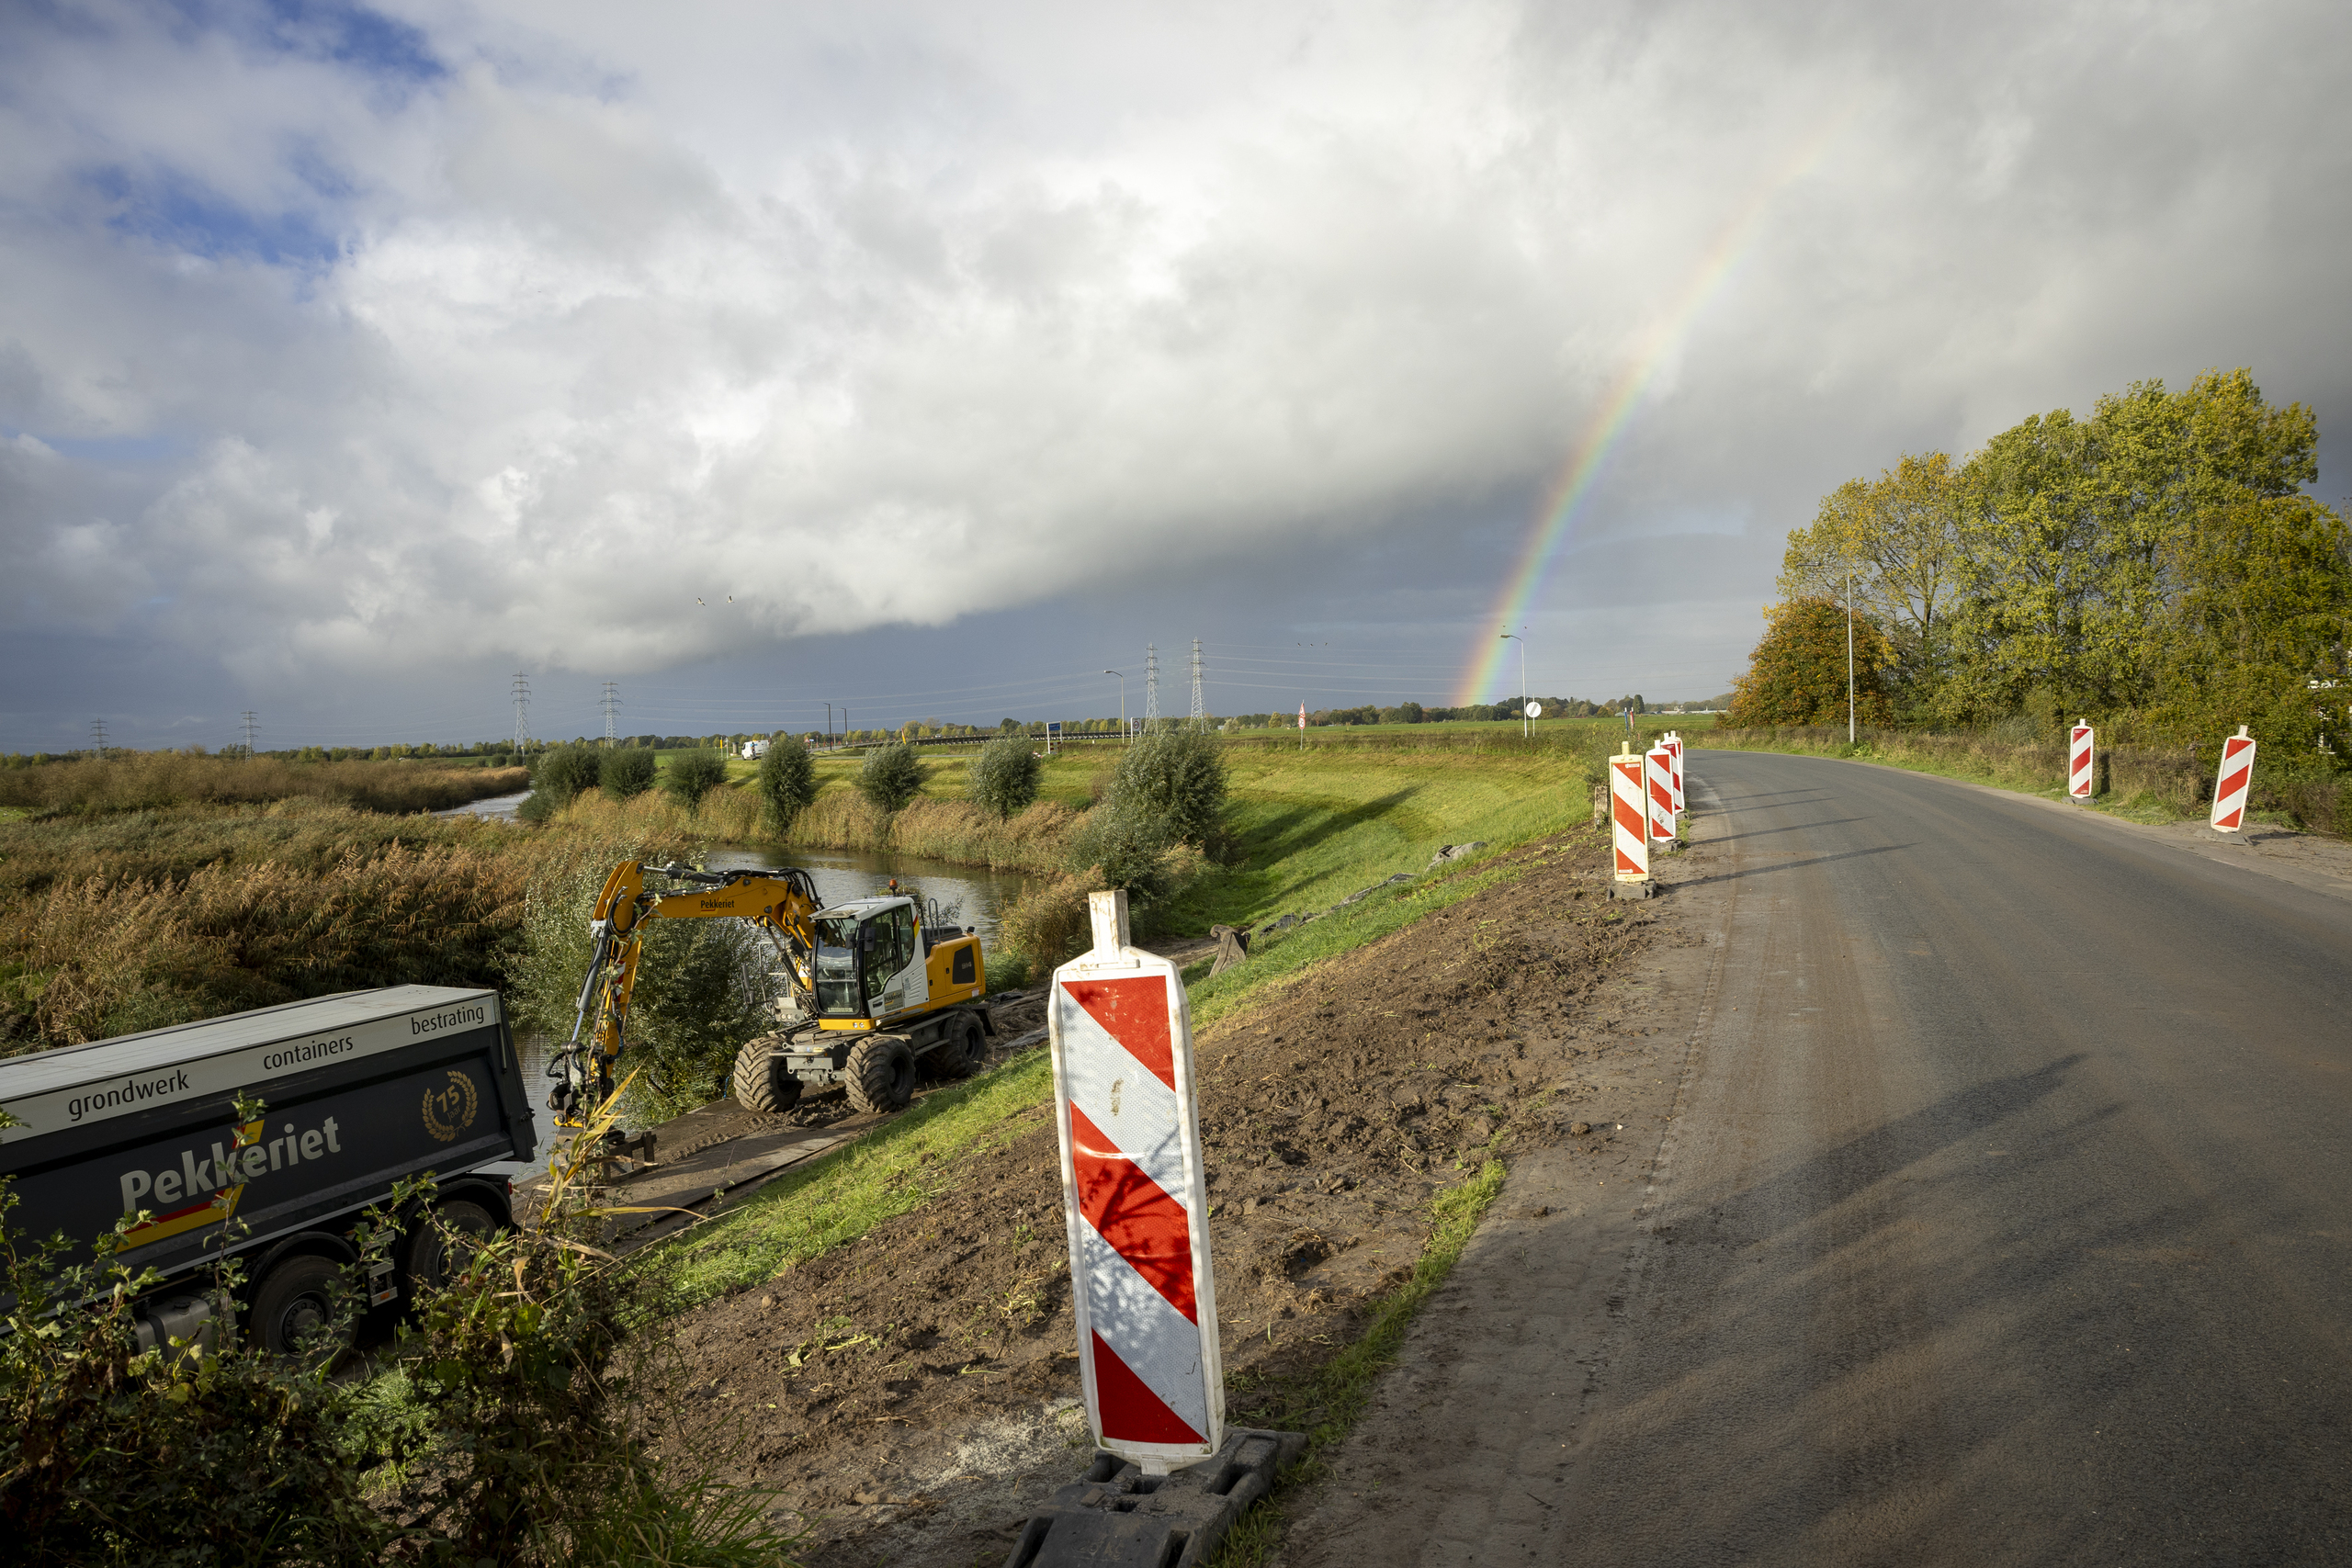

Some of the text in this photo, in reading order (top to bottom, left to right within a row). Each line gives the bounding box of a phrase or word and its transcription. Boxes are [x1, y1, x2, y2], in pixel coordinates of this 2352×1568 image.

[700, 899, 735, 908] Pekkeriet
[68, 1006, 484, 1122] grondwerk containers bestrating
[435, 1085, 460, 1113] 75
[119, 1116, 341, 1213] Pekkeriet
